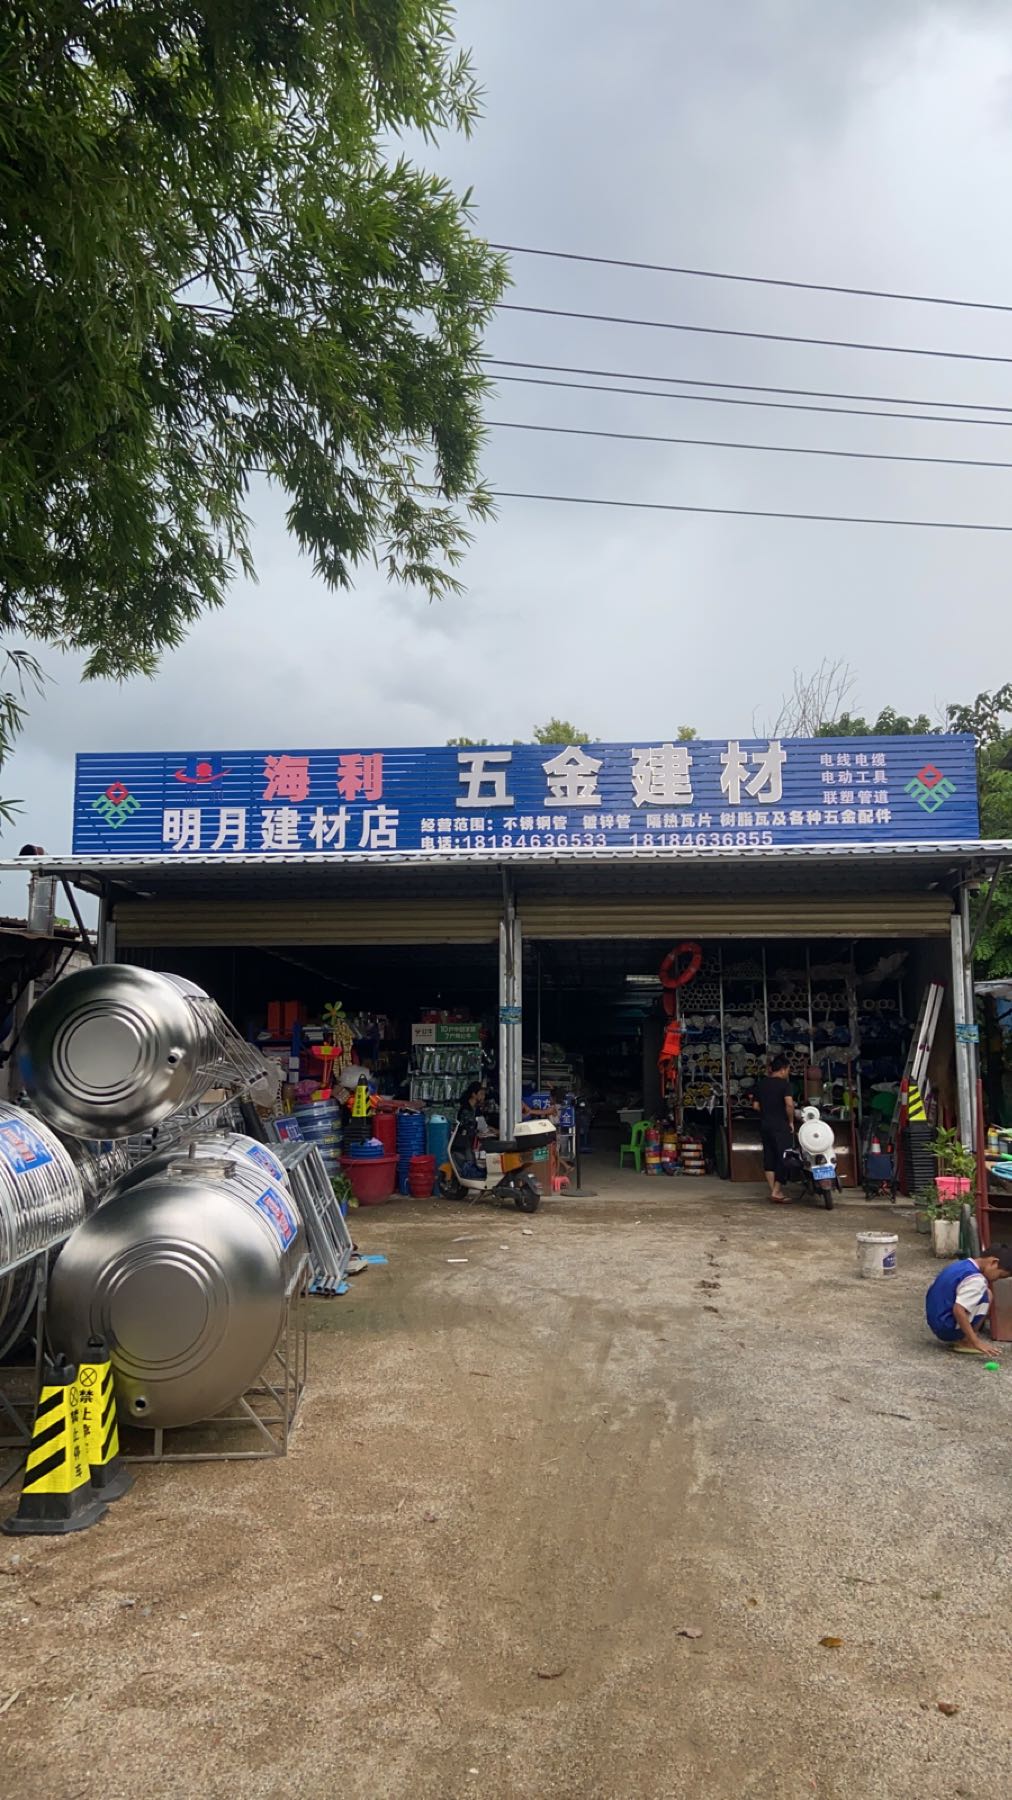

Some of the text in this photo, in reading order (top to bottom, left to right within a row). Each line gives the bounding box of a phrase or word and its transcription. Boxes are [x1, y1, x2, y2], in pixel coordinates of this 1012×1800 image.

[820, 753, 887, 767] 电线电缆
[263, 754, 384, 802] 海利
[456, 741, 787, 807] 五金建材
[821, 769, 888, 784] 电动工具
[823, 790, 889, 804] 联塑管道
[163, 804, 399, 851] 明月建材店
[583, 814, 631, 830] 镀锌管
[646, 813, 712, 828] 隔热瓦片
[720, 808, 892, 827] 树脂瓦及各种五金配件
[629, 831, 773, 847] 18184636855
